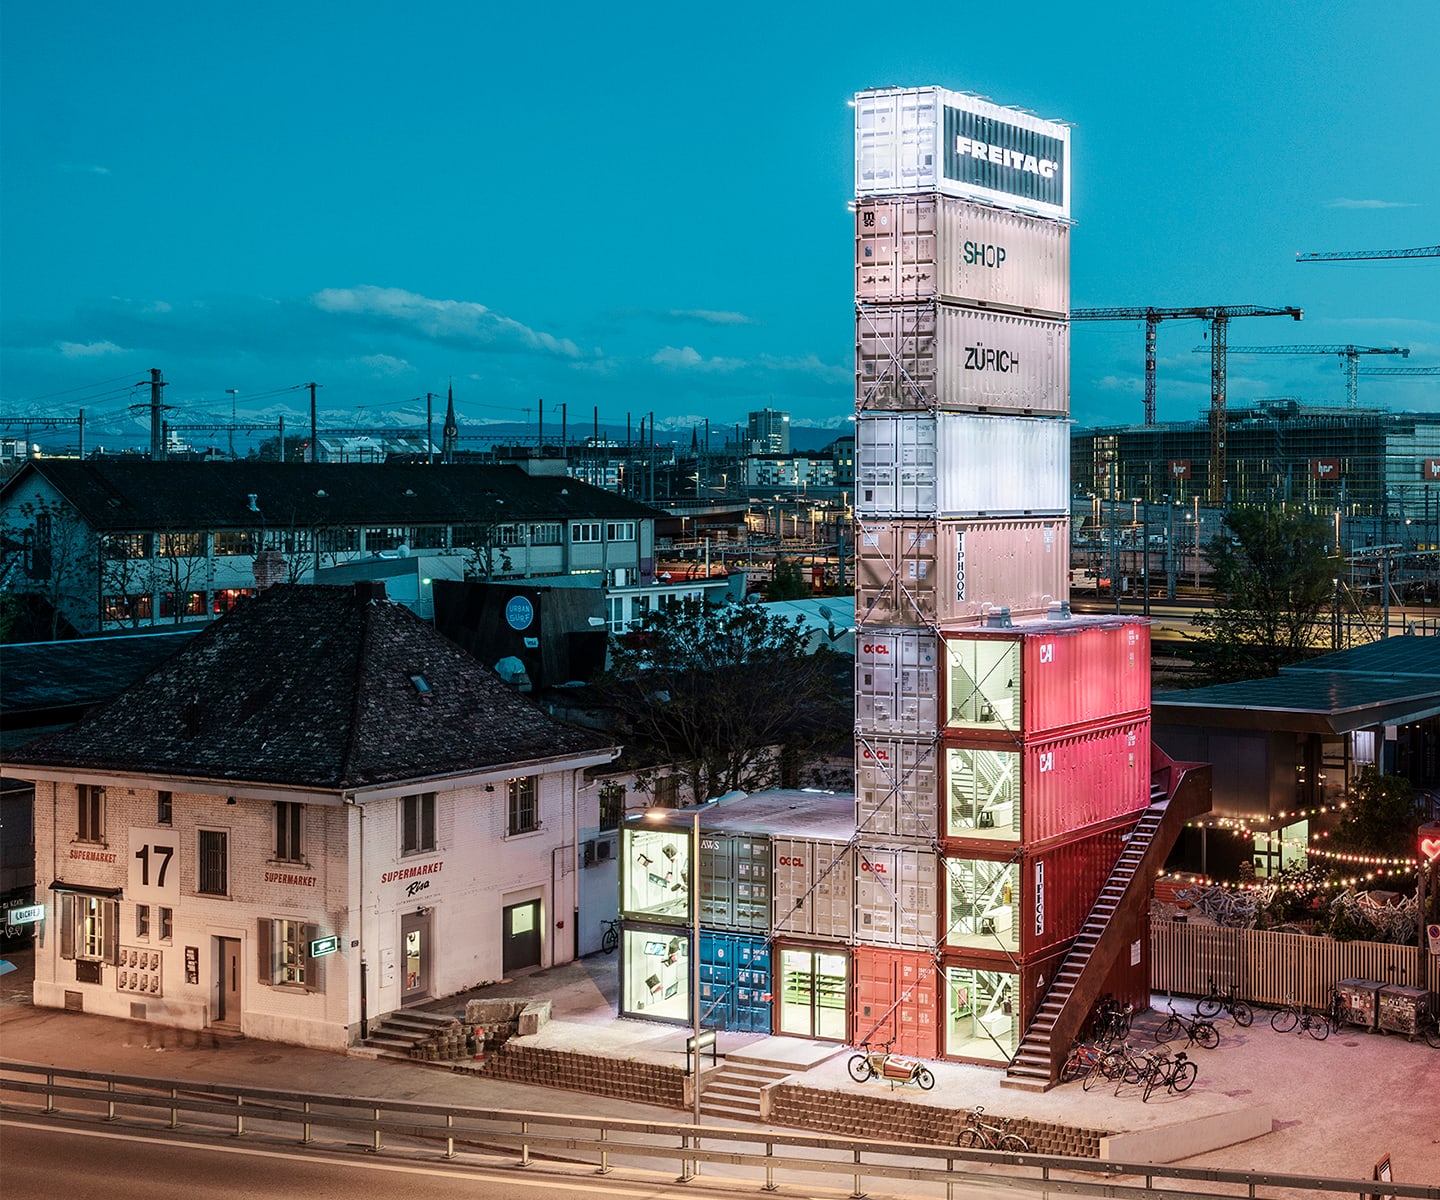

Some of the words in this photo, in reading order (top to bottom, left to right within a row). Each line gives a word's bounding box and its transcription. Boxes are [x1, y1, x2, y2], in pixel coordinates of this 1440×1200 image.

[963, 241, 1006, 269] SHOP
[964, 342, 1020, 374] ZÜRICH
[957, 532, 965, 601] TIPHOOK
[509, 604, 530, 613] URBAN
[510, 613, 530, 623] SURF
[700, 840, 720, 850] AWS
[69, 849, 117, 863] SUPERMARKET
[135, 844, 174, 887] 17
[264, 872, 317, 888] SUPERMARKET
[381, 862, 444, 884] SUPERMARKET
